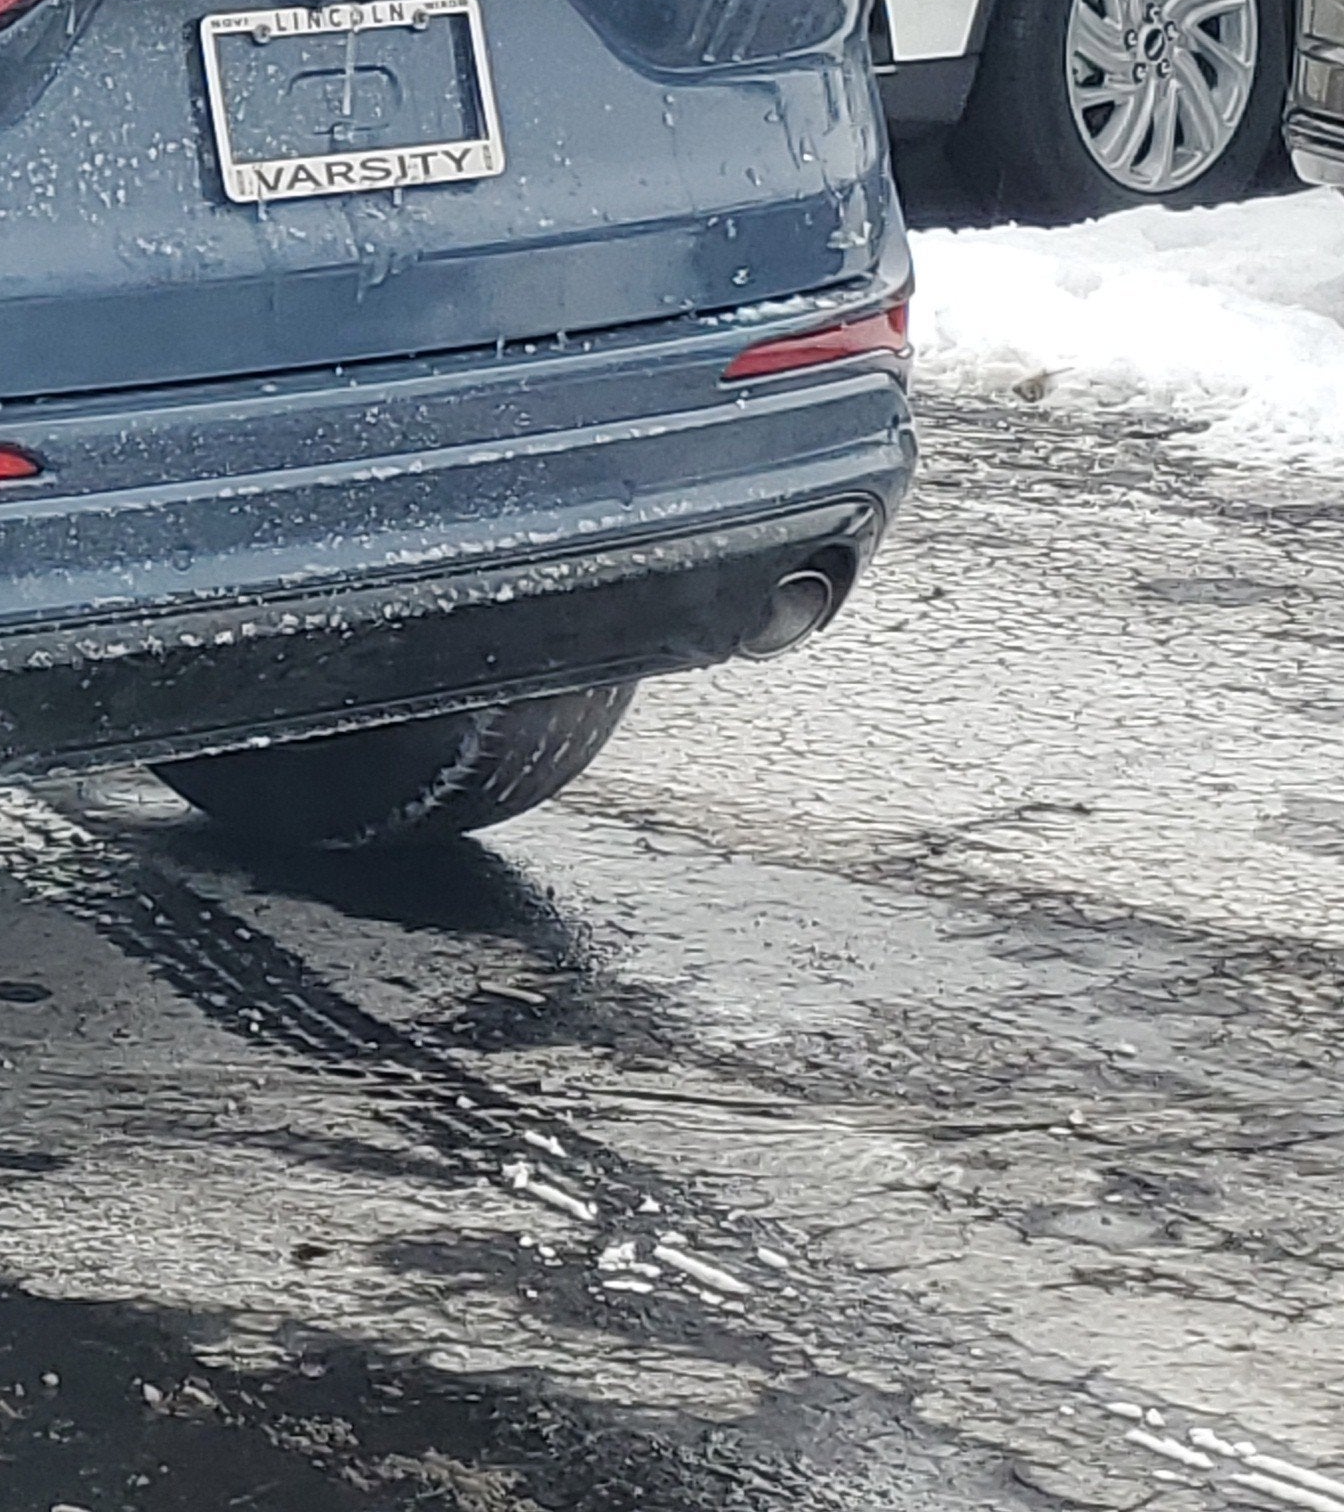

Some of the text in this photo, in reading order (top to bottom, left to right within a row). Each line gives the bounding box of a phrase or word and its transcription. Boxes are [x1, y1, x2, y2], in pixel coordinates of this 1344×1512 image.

[211, 17, 249, 29] NOVI
[275, 2, 404, 32] LINCOLN
[255, 147, 472, 191] VARSITY
